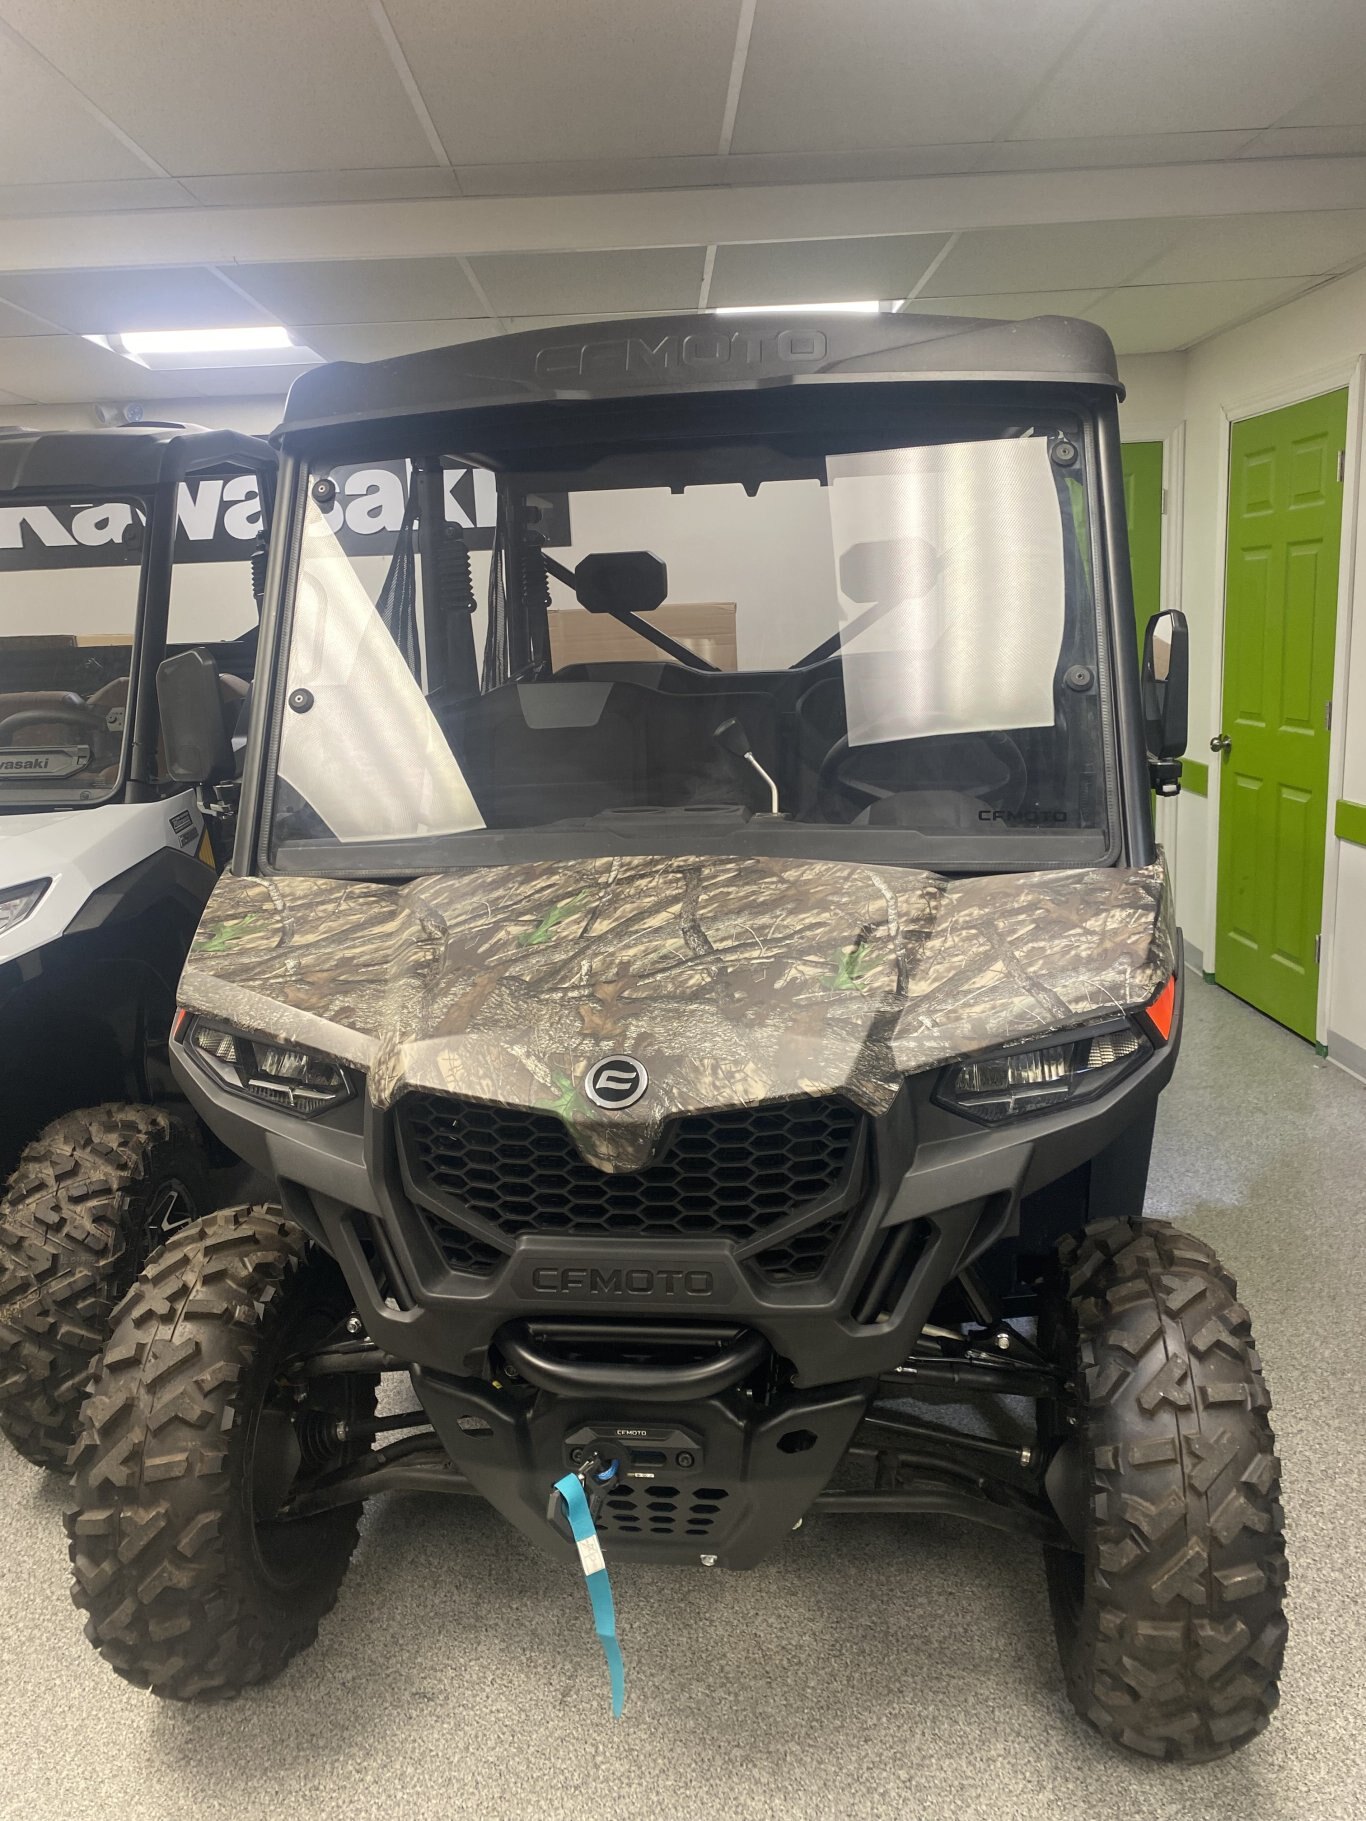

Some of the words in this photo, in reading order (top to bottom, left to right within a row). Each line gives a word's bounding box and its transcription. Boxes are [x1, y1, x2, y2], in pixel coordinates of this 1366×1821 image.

[534, 329, 829, 379] CFMOTO
[978, 810, 1067, 822] CFMOTO
[532, 1267, 714, 1296] CFMOTO
